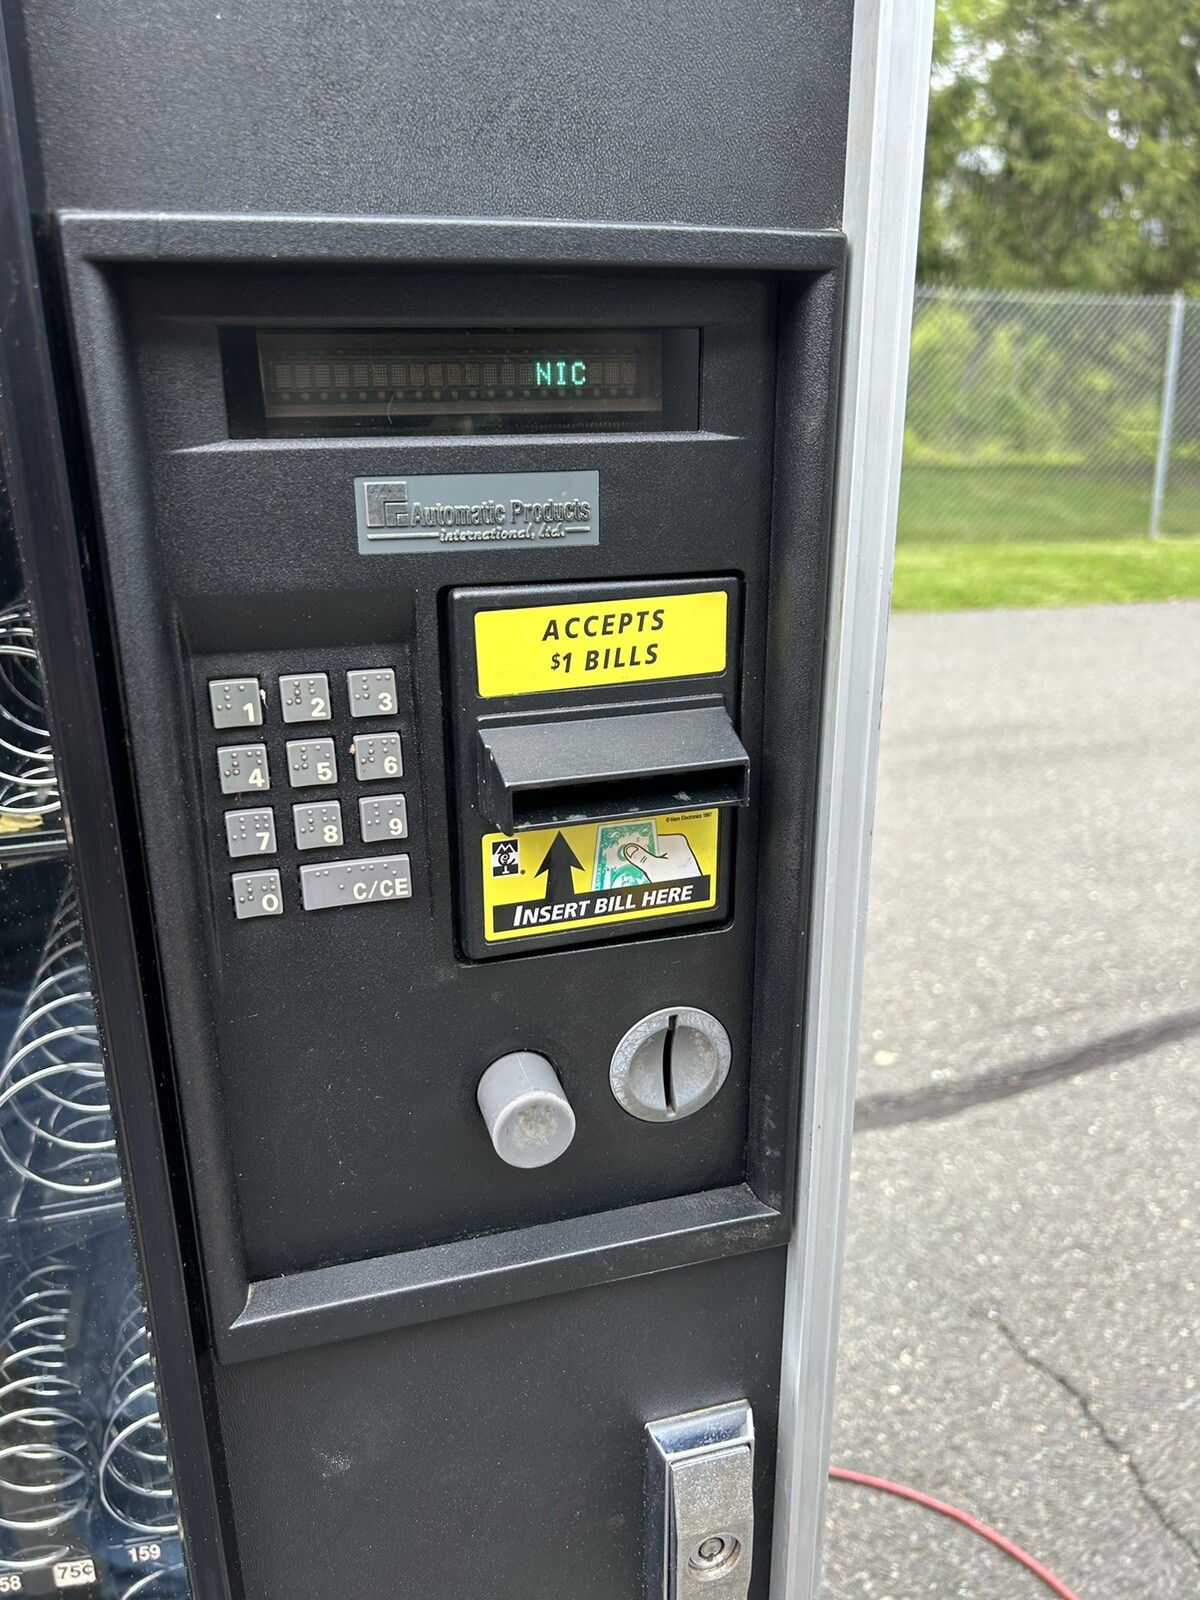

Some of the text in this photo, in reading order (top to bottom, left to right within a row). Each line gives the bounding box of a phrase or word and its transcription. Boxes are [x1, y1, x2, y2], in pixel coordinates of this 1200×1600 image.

[536, 361, 586, 386] NIC
[411, 498, 592, 527] Automatic Products
[542, 609, 665, 642] ACCEPTS
[550, 643, 659, 674] $1 BILLS
[243, 702, 255, 722] 1
[310, 697, 327, 718] 2
[378, 692, 393, 712] 3
[316, 762, 332, 781] 5
[383, 756, 398, 775] 6
[248, 768, 265, 788] 4
[323, 825, 339, 843] 8
[389, 817, 403, 836] 9
[255, 831, 270, 851] 7
[352, 877, 409, 901] C/CE
[594, 895, 637, 915] BILL
[641, 885, 694, 907] HERE
[127, 1544, 162, 1563] 159
[57, 1562, 95, 1581] 75¢
